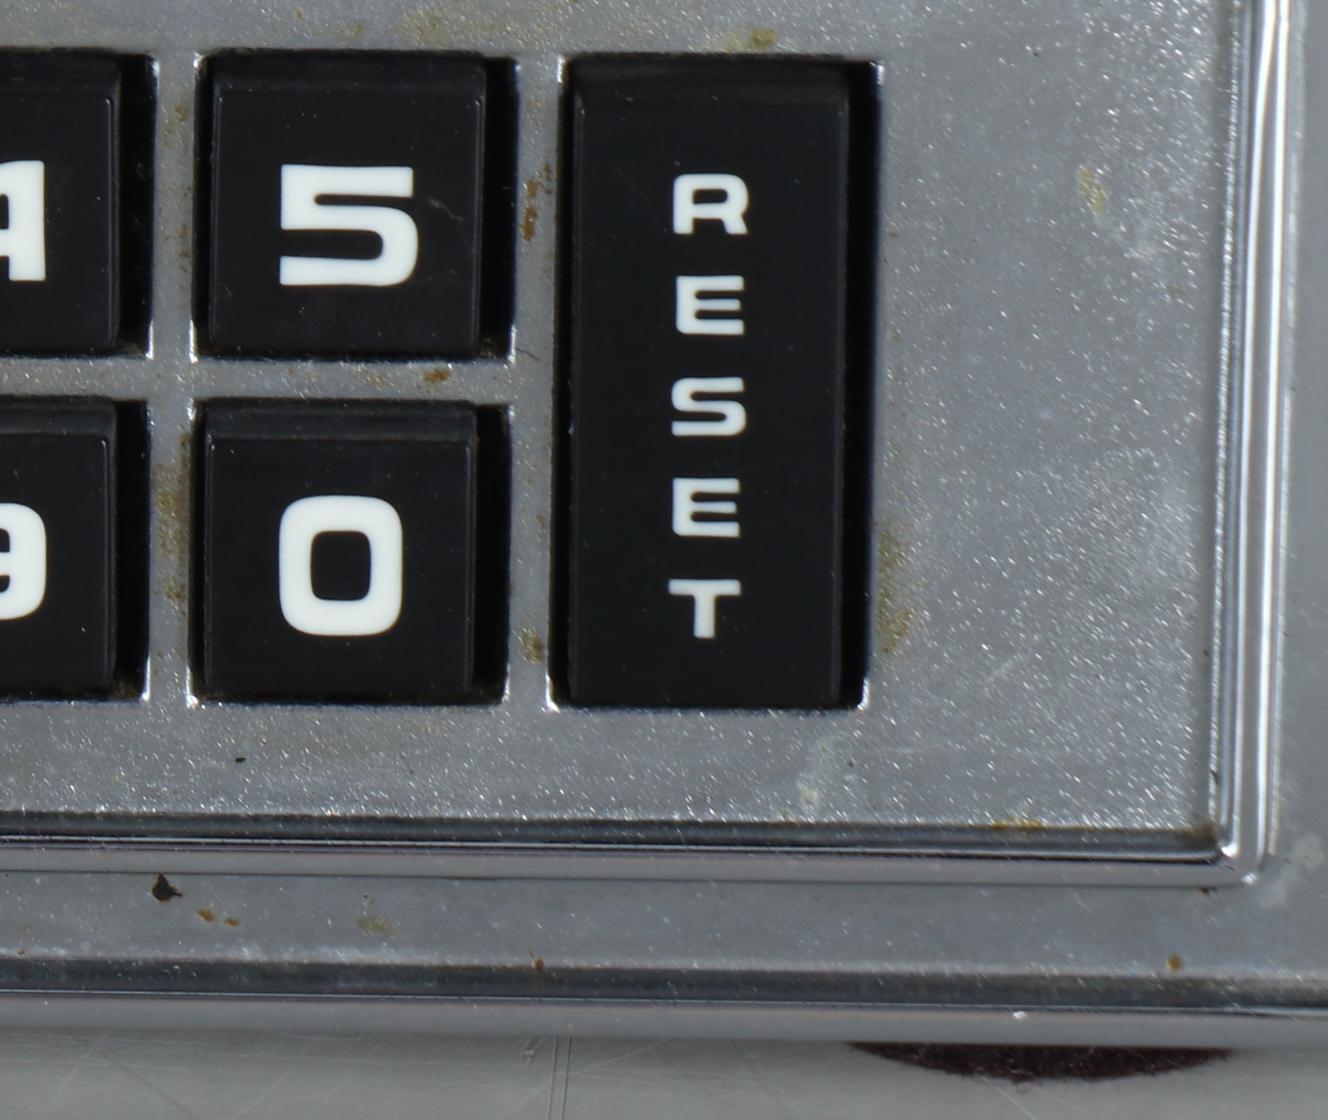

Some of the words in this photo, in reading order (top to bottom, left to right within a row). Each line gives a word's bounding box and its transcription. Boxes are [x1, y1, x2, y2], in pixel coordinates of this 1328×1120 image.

[279, 164, 418, 287] 5
[669, 174, 748, 638] RESET
[279, 495, 403, 636] 0
